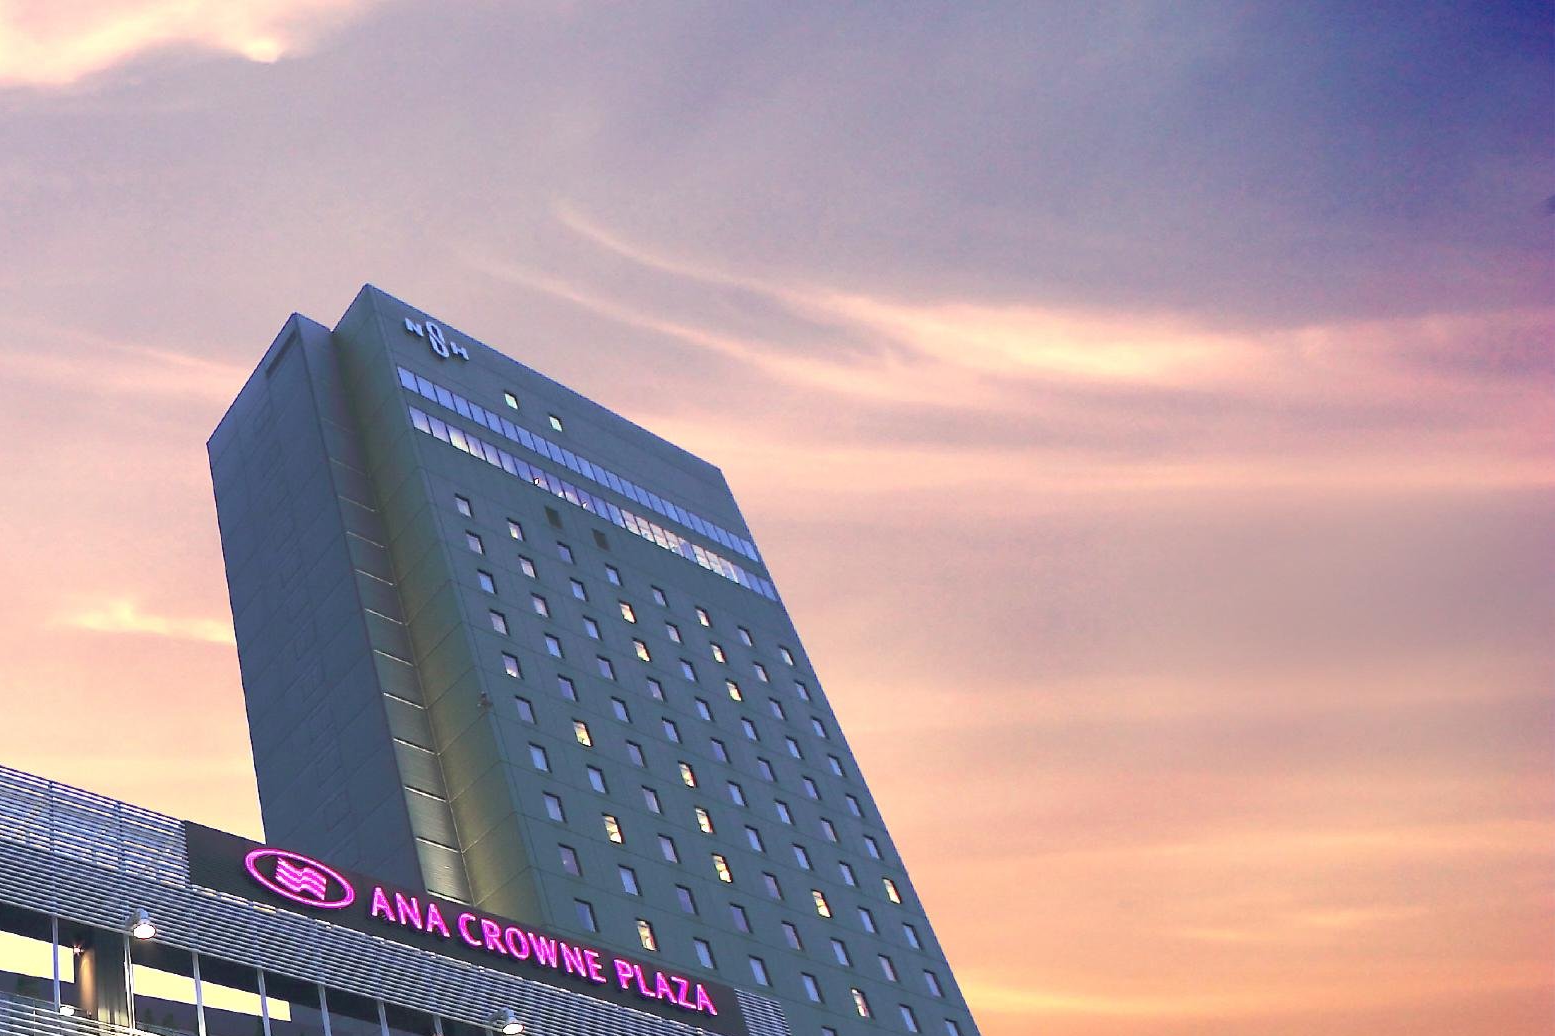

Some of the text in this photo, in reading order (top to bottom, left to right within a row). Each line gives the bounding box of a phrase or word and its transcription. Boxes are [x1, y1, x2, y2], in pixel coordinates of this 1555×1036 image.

[371, 886, 719, 1016] ANA CROWNE PLAZA
